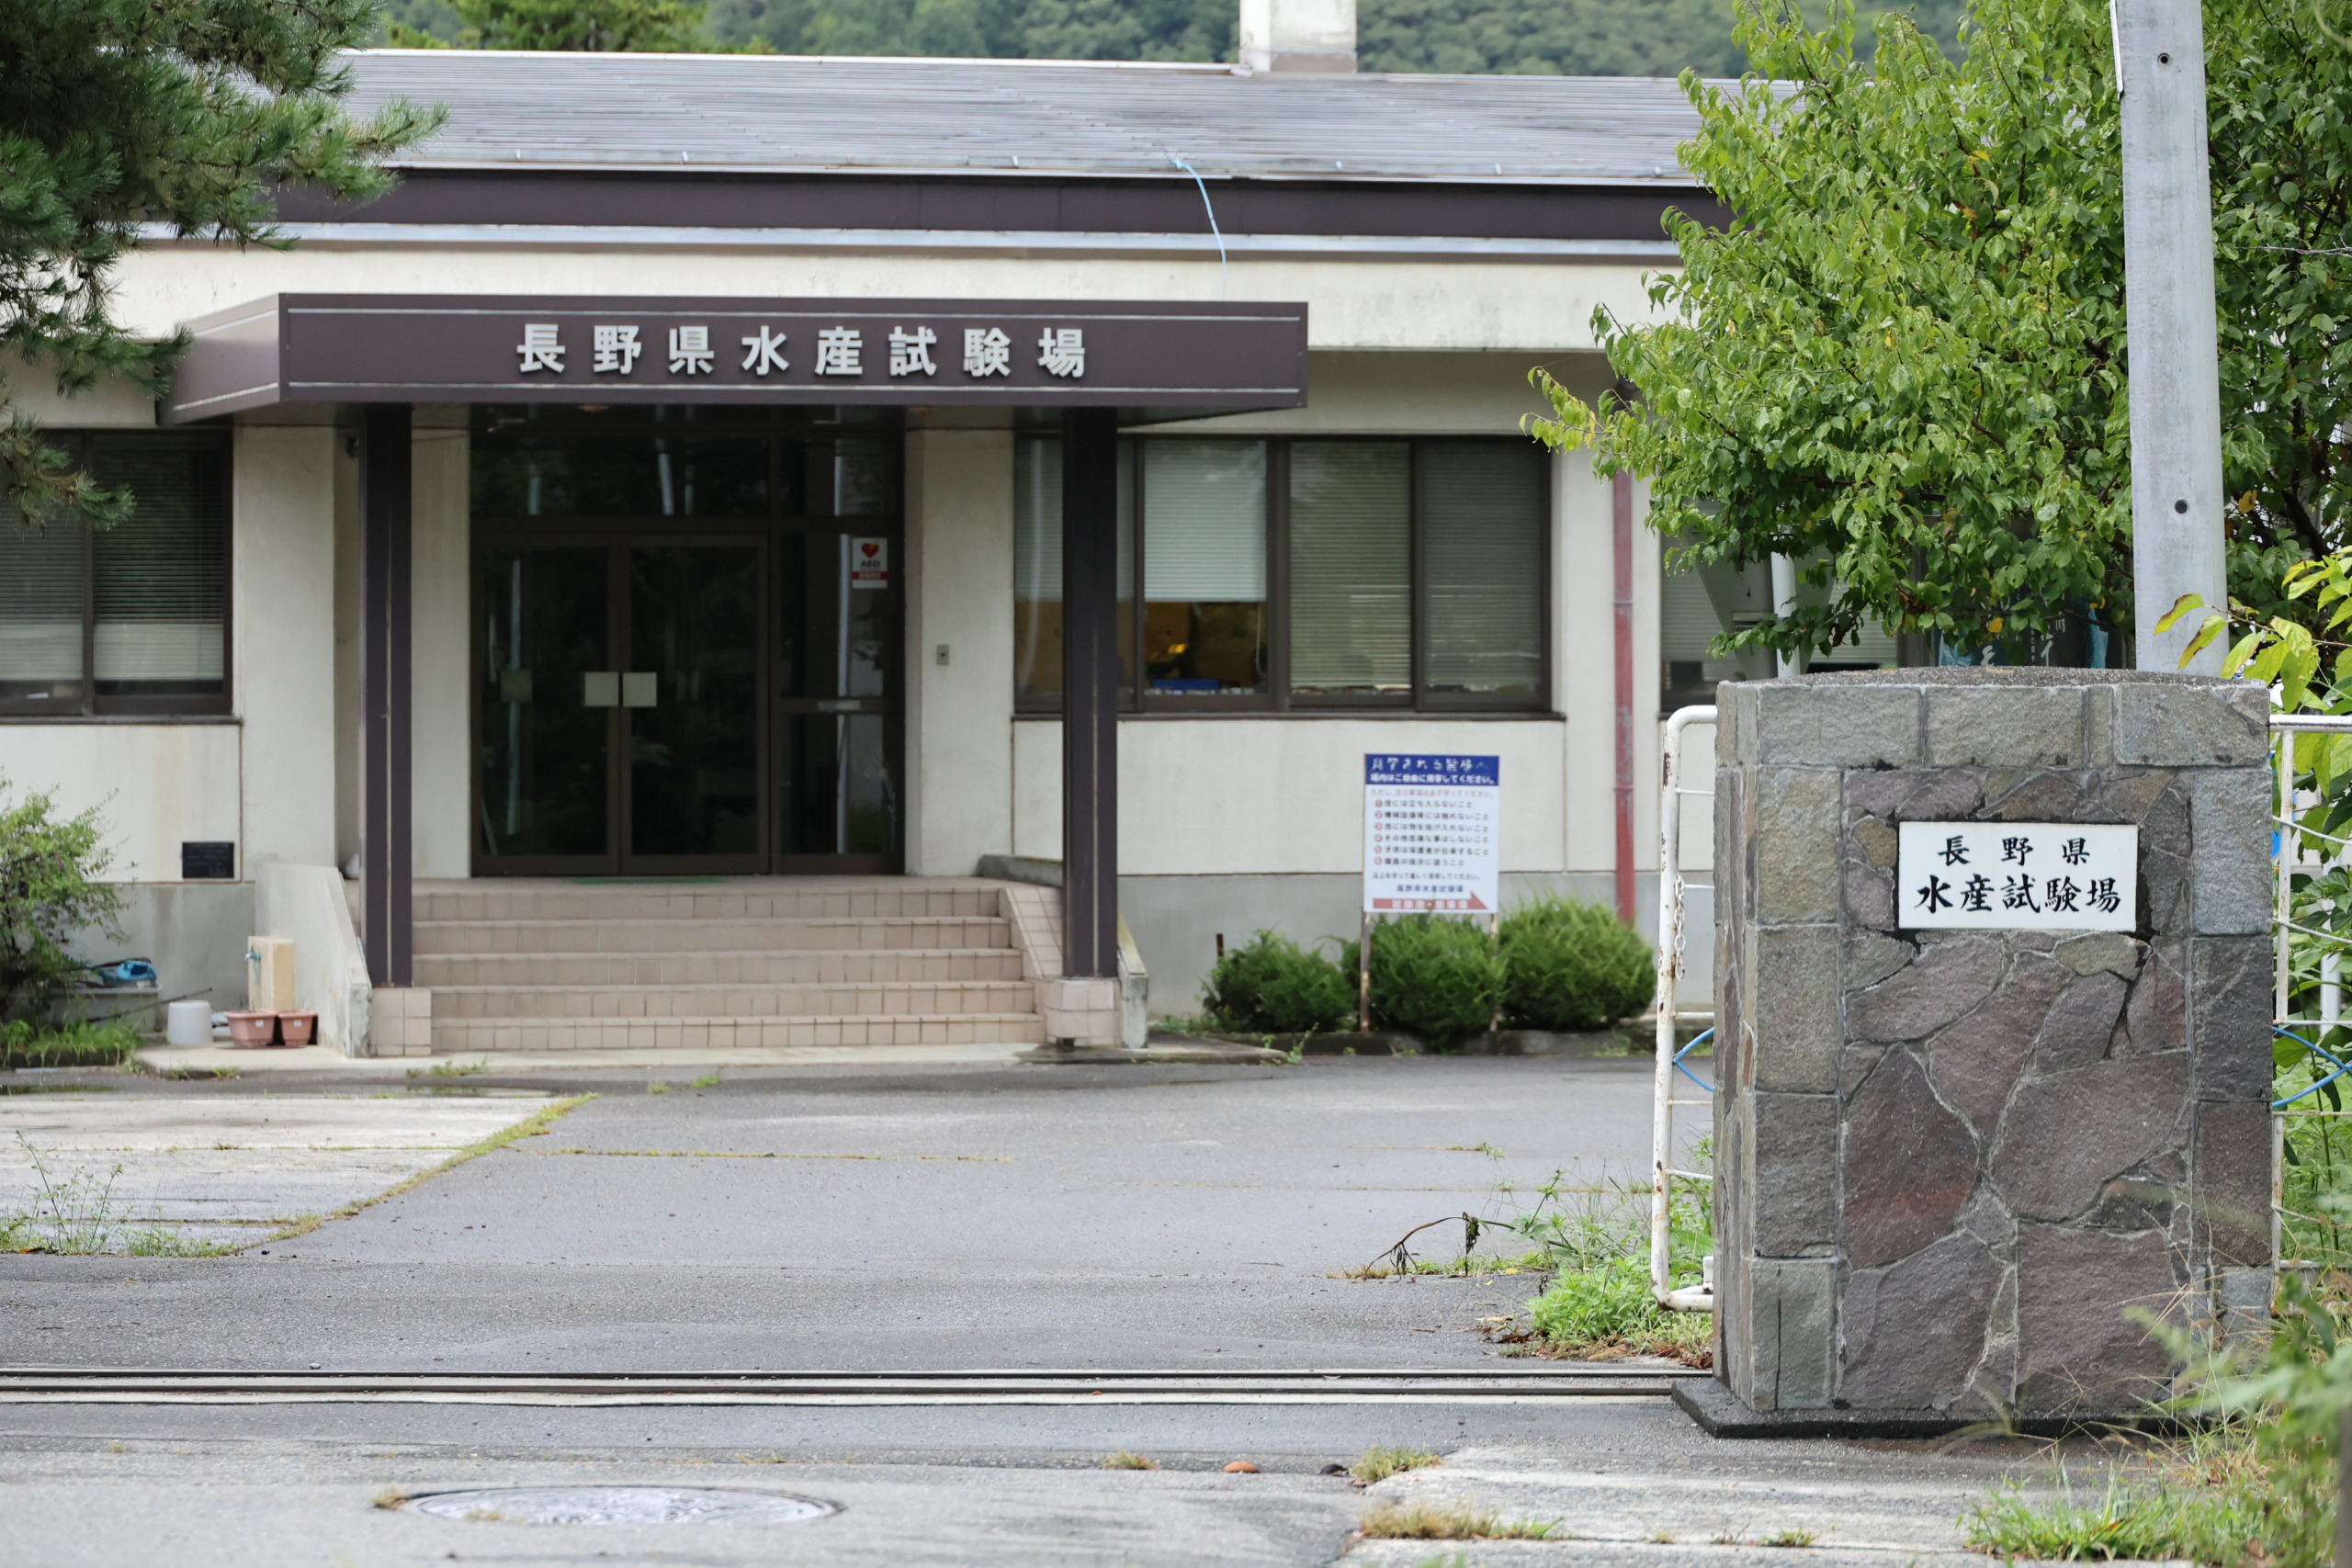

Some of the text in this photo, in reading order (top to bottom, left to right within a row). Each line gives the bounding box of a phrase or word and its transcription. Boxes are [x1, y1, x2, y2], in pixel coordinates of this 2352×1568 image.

[516, 323, 1085, 378] 長野県水産試験場
[1938, 834, 2091, 866] 長野県
[1914, 874, 2122, 913] 水産試験場
